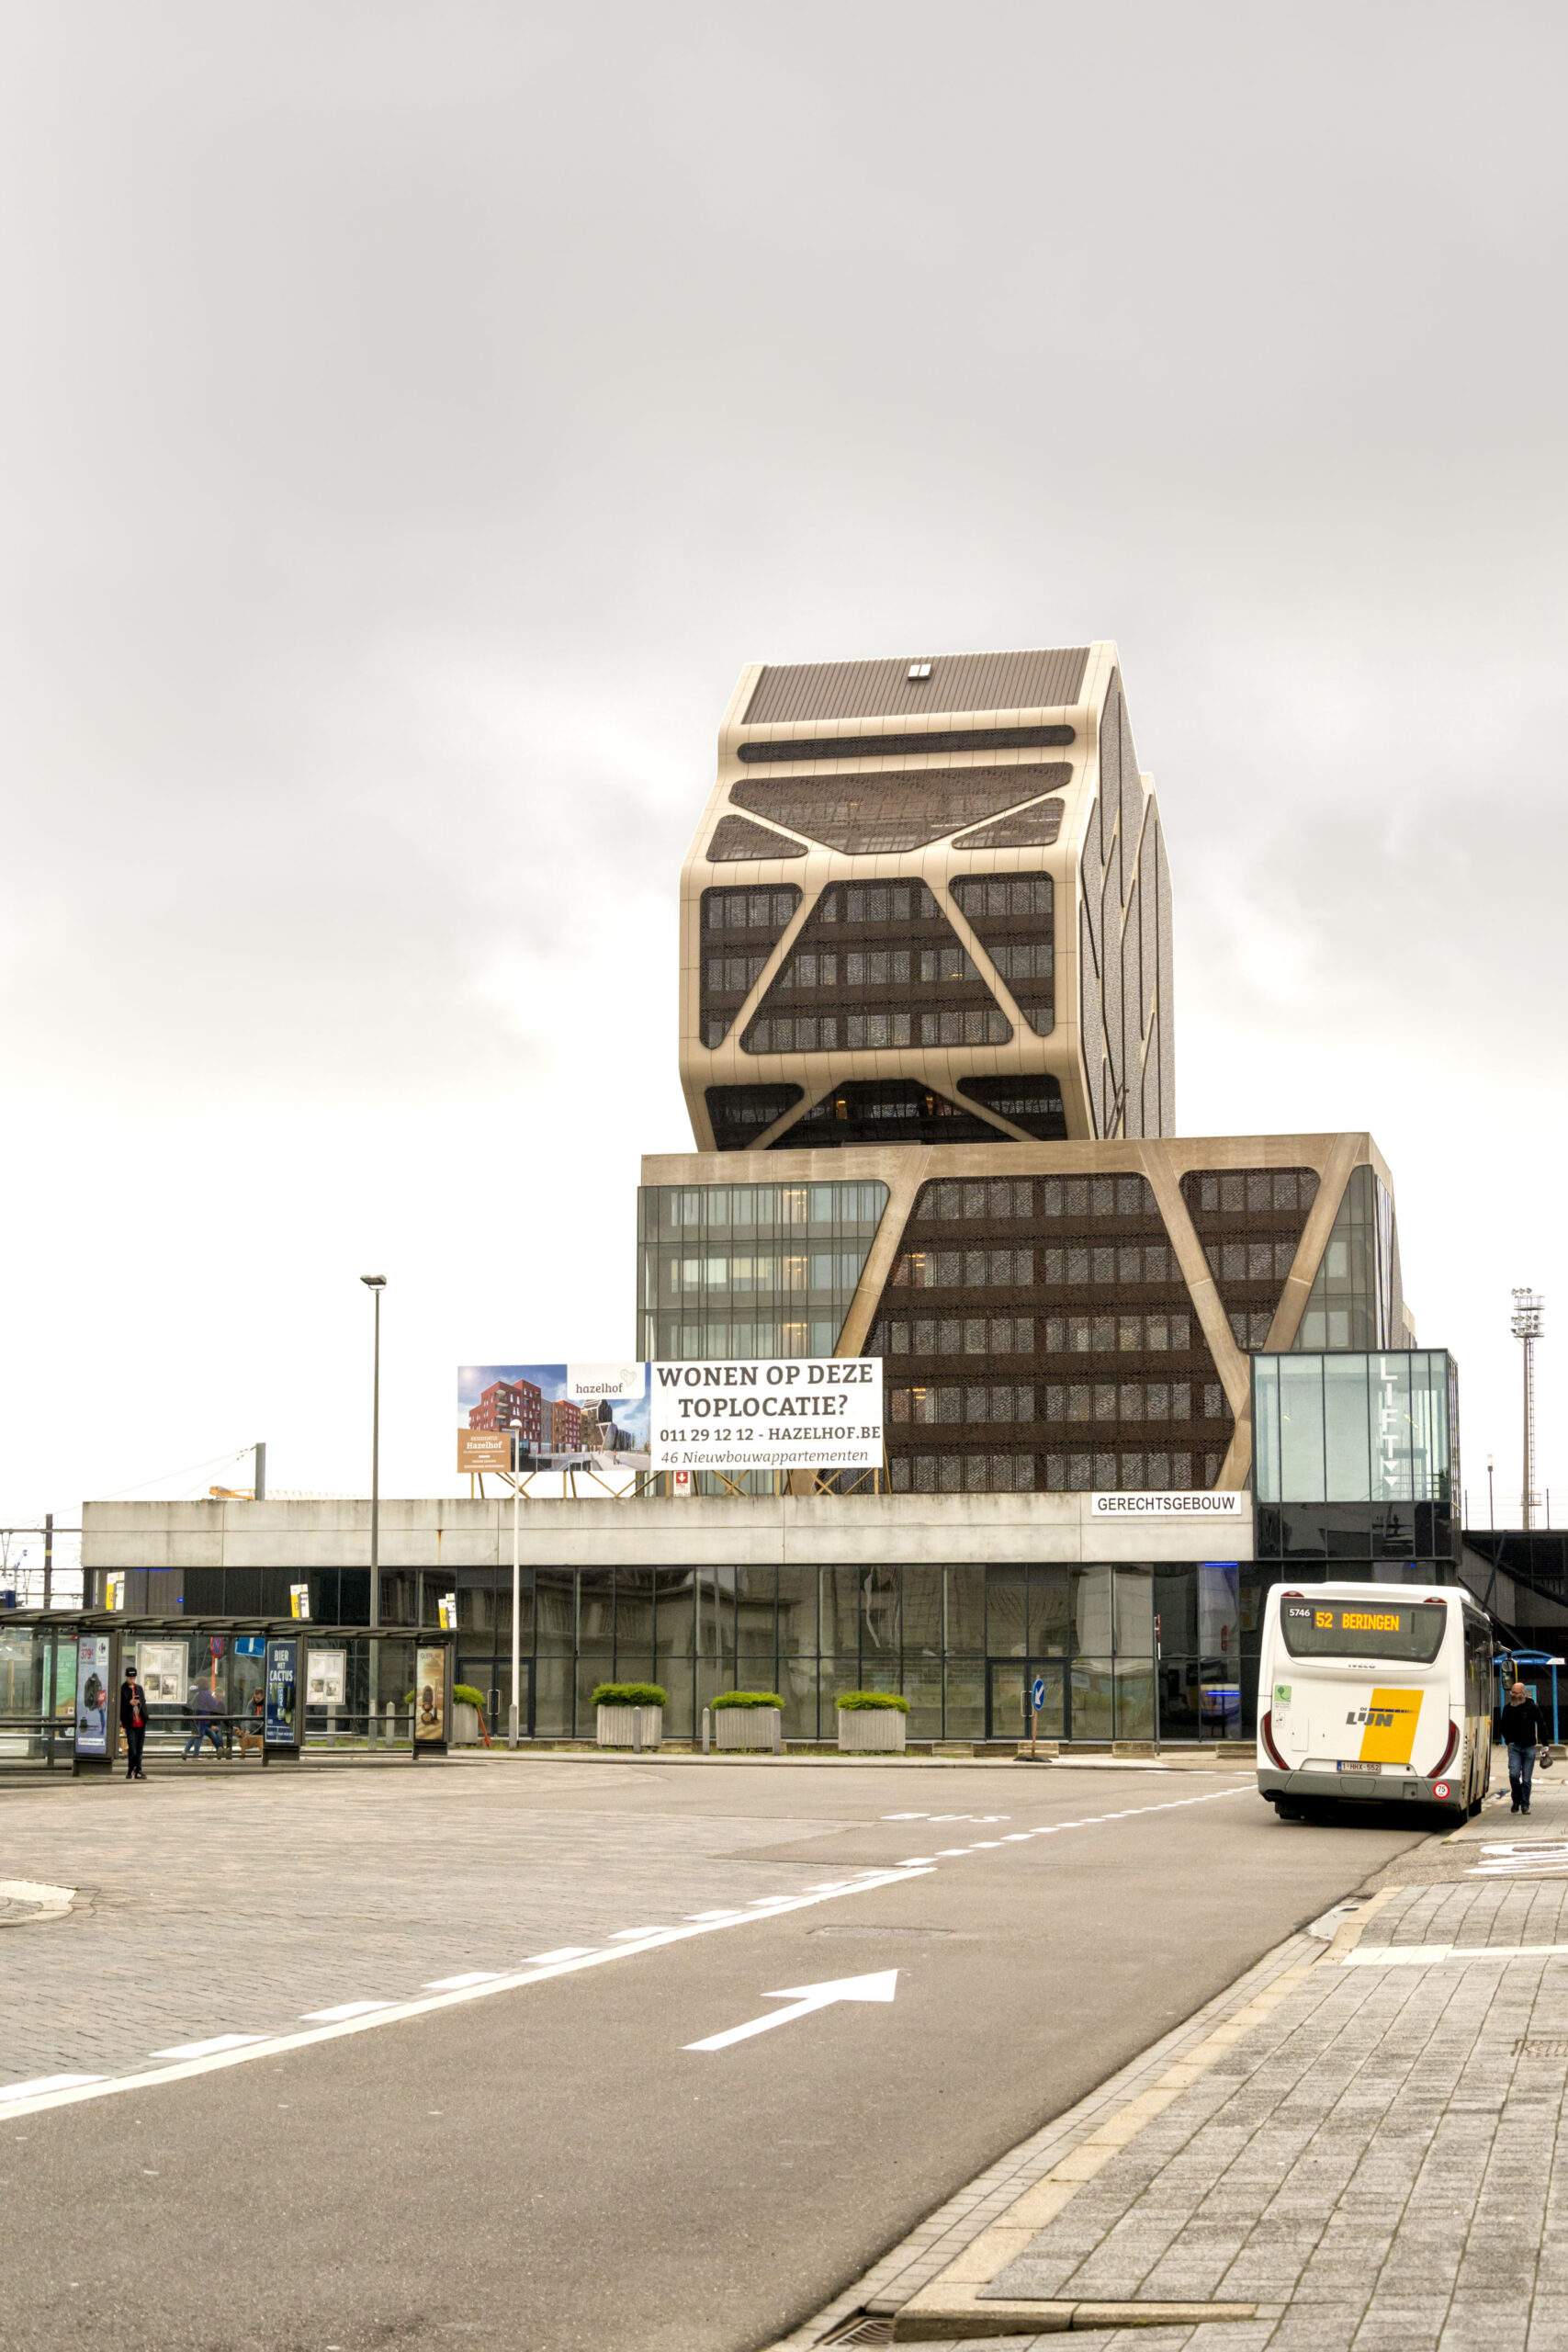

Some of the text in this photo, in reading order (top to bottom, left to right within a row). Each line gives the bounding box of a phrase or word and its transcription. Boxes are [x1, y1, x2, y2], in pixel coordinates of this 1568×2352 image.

[657, 1363, 873, 1387] WONEN OP DEZE
[575, 1383, 624, 1394] hazelhof
[678, 1394, 849, 1418] TOPLOCATIE?
[1380, 1356, 1399, 1459] LIFT
[660, 1429, 686, 1442] 011
[691, 1429, 709, 1442] 29
[714, 1428, 731, 1442] 12
[737, 1428, 753, 1441] 12
[768, 1426, 881, 1441] HAZELHOF.BE
[466, 1441, 502, 1449] Hazelhof
[661, 1450, 869, 1465] 46 Nieuwbouwappartementen
[1097, 1497, 1235, 1510] GERECHTSGEBOUW
[1289, 1608, 1311, 1617] 5746
[1315, 1611, 1400, 1631] 52 BERINGEN
[274, 1649, 289, 1662] BIER
[269, 1670, 293, 1682] CACTUS
[880, 1812, 1011, 1823] BUS
